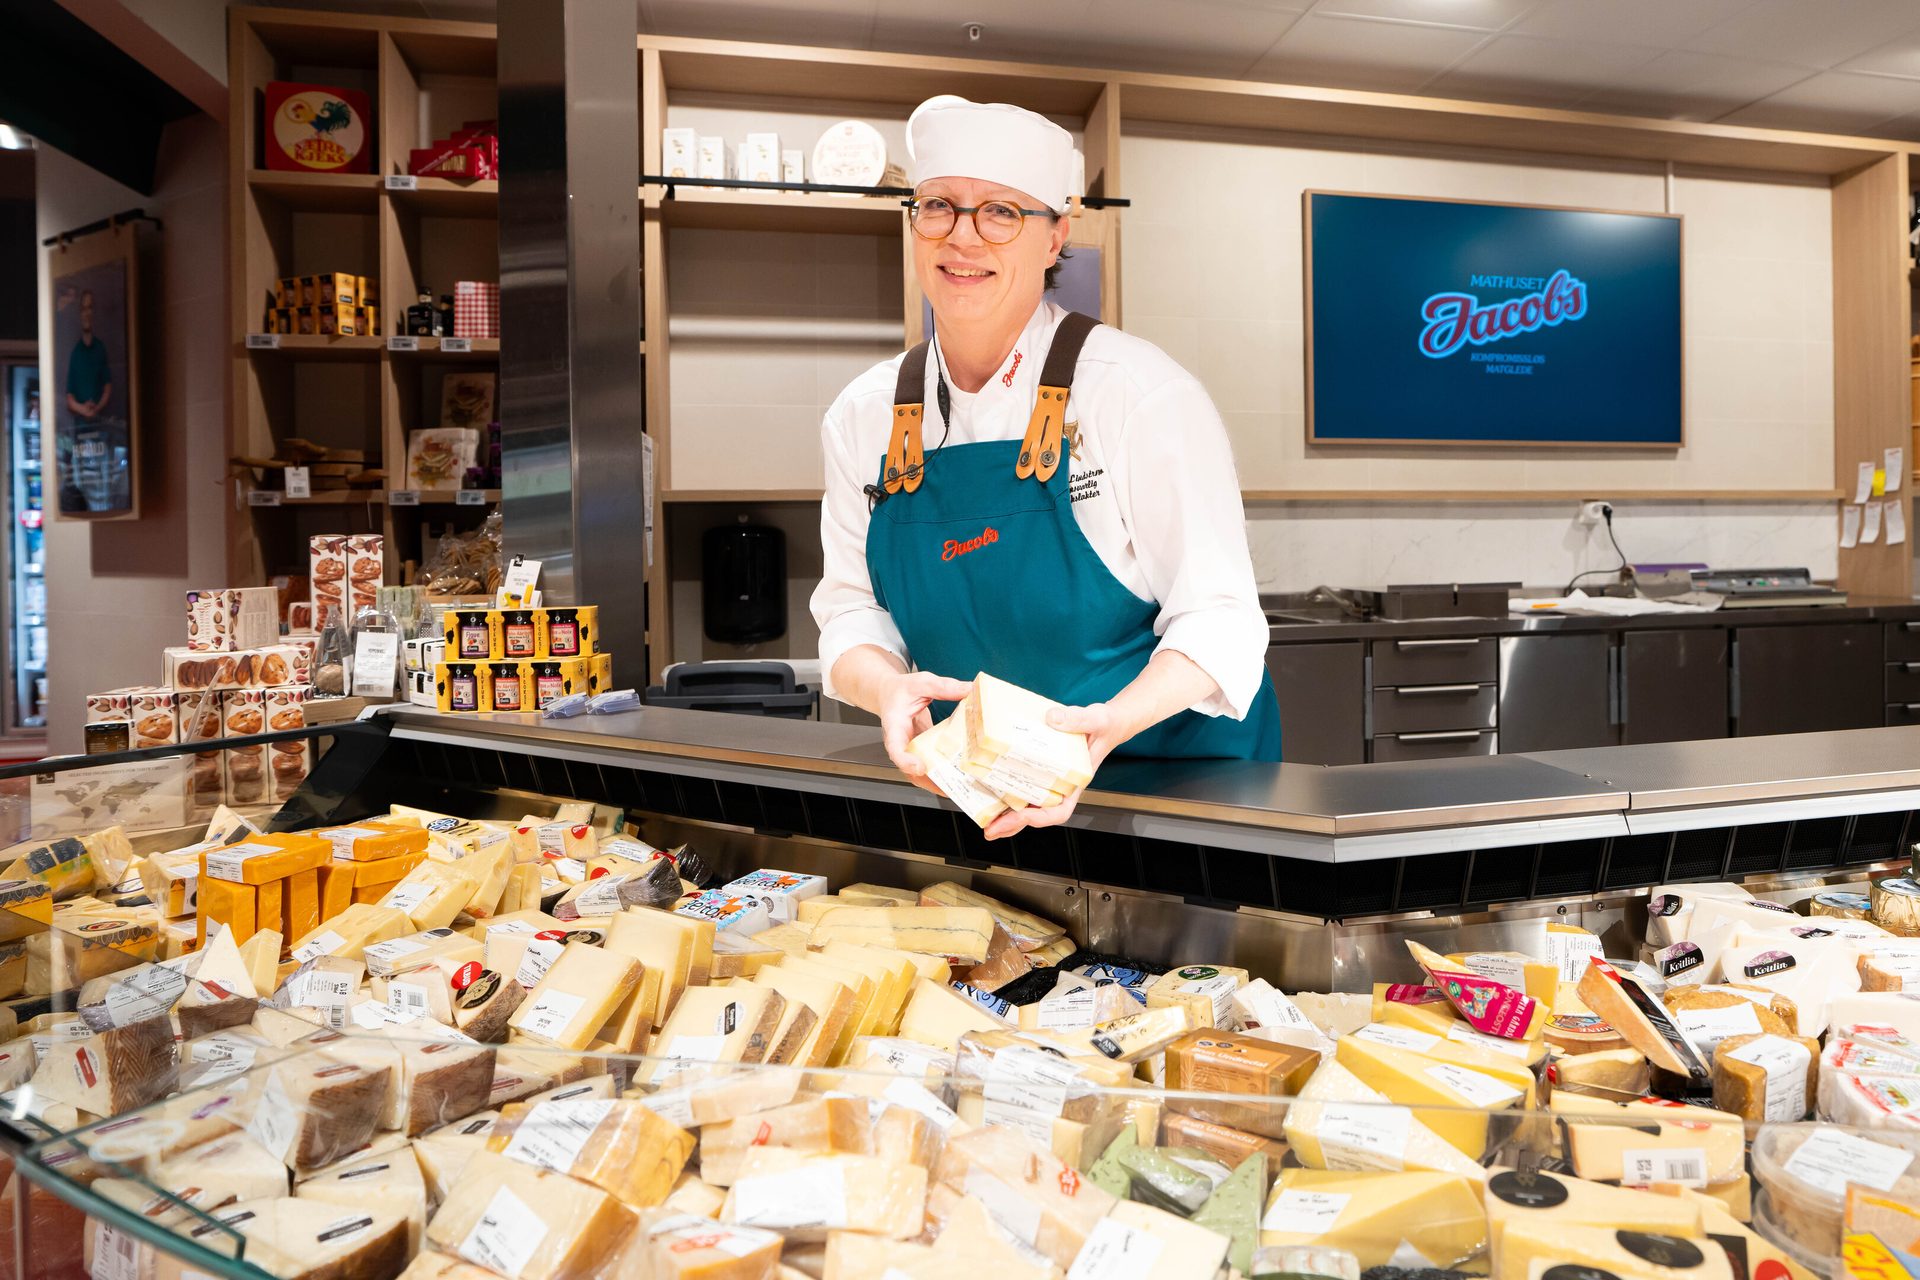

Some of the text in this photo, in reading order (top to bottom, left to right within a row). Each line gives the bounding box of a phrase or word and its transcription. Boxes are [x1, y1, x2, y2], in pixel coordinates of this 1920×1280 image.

[295, 150, 346, 164] KJEKS
[1471, 274, 1545, 290] MATHUSET
[1419, 269, 1587, 358] Jacob's
[1002, 349, 1023, 387] Jacob's
[1486, 364, 1534, 375] MATGLEDE
[941, 527, 999, 561] Jacob's
[1669, 957, 1698, 973] Kvitlin
[1753, 961, 1788, 976] Kvitlin
[462, 963, 472, 987] TILBUD
[1218, 1052, 1269, 1069] Undredal
[1206, 1122, 1257, 1145] Undredal
